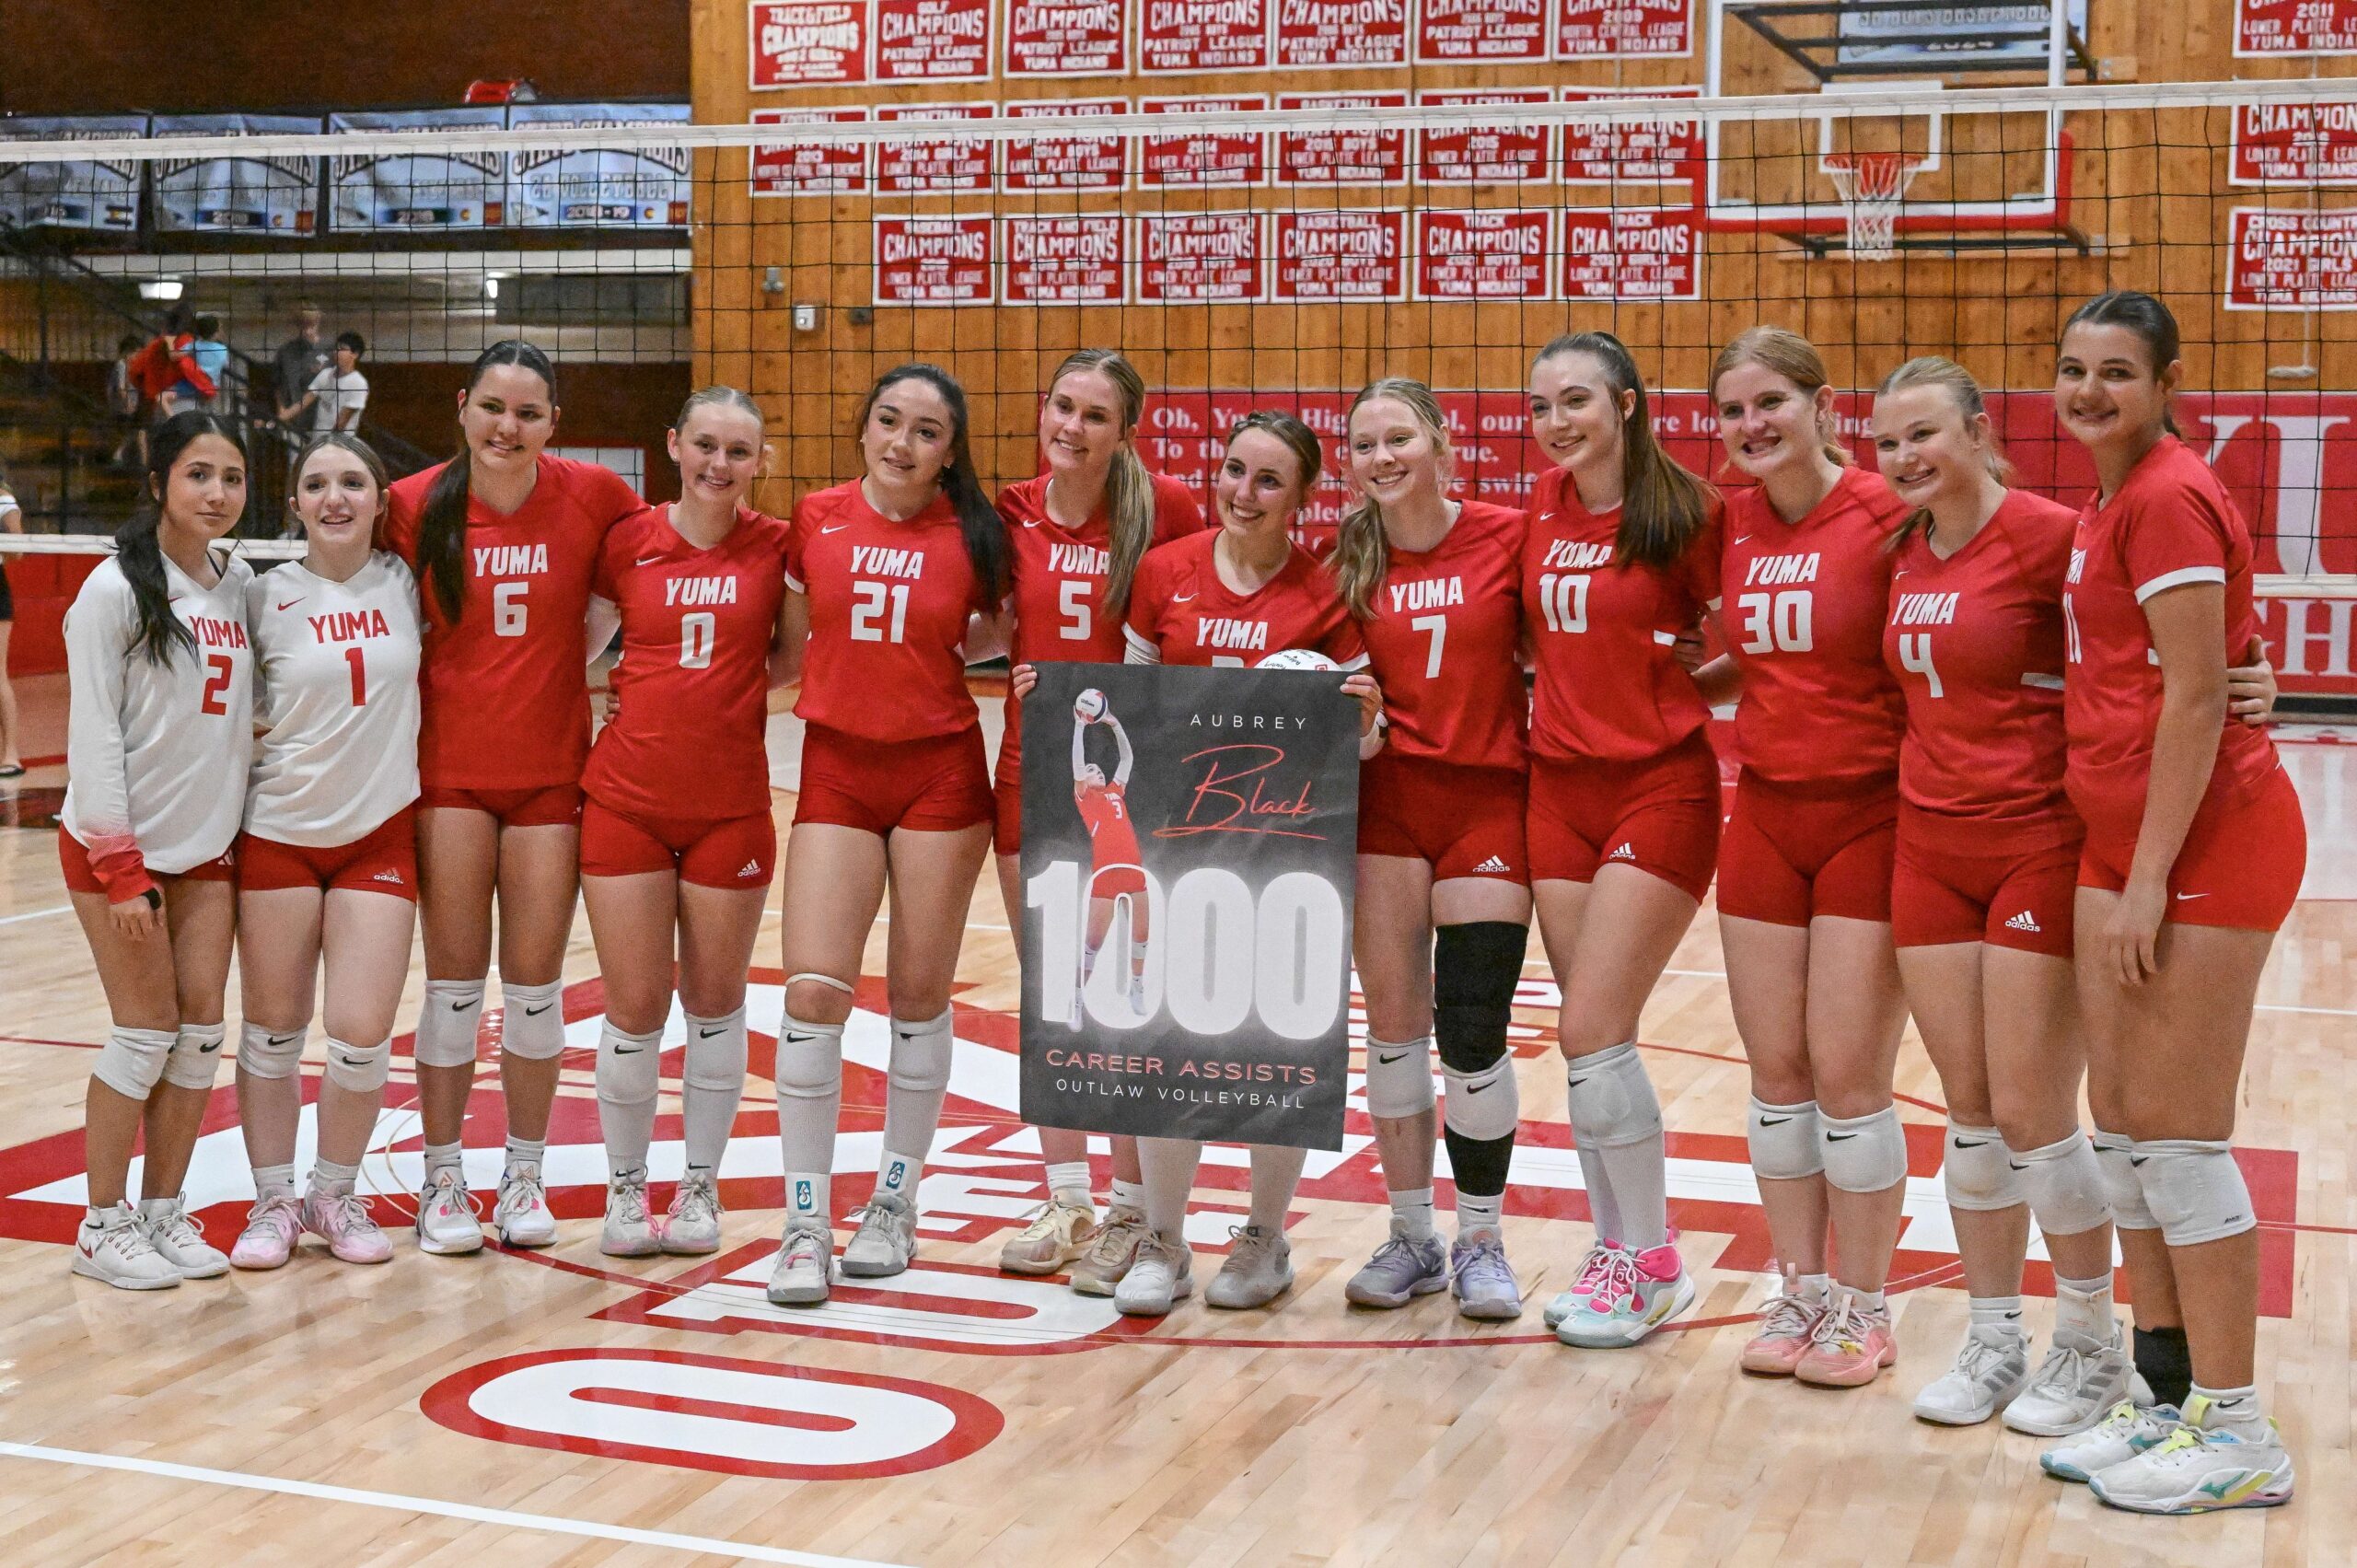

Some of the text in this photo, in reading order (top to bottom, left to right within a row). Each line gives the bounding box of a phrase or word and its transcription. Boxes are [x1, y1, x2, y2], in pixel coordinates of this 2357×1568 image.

[883, 8, 984, 42] CHAMPIONS
[1016, 2, 1120, 36] CHAMPIONS
[1151, 0, 1260, 30] CHAMPIONS
[1282, 0, 1402, 26] CHAMPIONS
[2296, 2, 2334, 18] 2011
[761, 21, 859, 56] CHAMPIONS
[1281, 34, 1402, 51] PATRIOT LEAGUE
[1426, 23, 1540, 39] PATRIOT LEAGUE
[2243, 19, 2282, 35] LOWER
[2250, 33, 2357, 49] YUMA INDIA
[1014, 40, 1119, 55] PATRIOT LEAGUE
[1144, 35, 1264, 52] PATRIOT LEAGUE
[1152, 52, 1190, 66] YUMA
[1289, 50, 1327, 64] YUMA
[1437, 40, 1472, 53] YUMA
[1566, 39, 1608, 52] YUMA
[2247, 104, 2357, 135] CHAMPION
[2246, 147, 2281, 162] LOWER
[2333, 146, 2357, 161] LEA
[2258, 163, 2299, 177] YUMA
[1296, 215, 1381, 230] BASKETBALL
[1461, 214, 1506, 228] TRACK
[2248, 215, 2299, 231] CROSS
[885, 232, 985, 262] CHAMPIONS
[1014, 231, 1119, 262] CHAMPIONS
[1148, 229, 1255, 261] CHAMPIONS
[1284, 227, 1395, 259] CHAMPIONS
[1429, 226, 1541, 256] CHAMPIONS
[1572, 225, 1689, 256] CHAMPIONS
[2243, 230, 2357, 261] CHAMPION
[1437, 281, 1472, 295] YUMA
[1152, 407, 1199, 431] Oh,
[1301, 408, 1348, 436] Hig
[1480, 415, 1530, 432] our
[1152, 437, 1184, 459] To
[1199, 437, 1228, 459] th
[1478, 471, 1538, 494] swif
[473, 543, 549, 578] YUMA
[850, 544, 924, 580] YUMA
[1047, 542, 1110, 583] YUMA
[1541, 539, 1612, 569] YUMA
[1744, 552, 1820, 587] YUMA
[666, 575, 737, 608] YUMA
[1390, 575, 1464, 613] YUMA
[1538, 573, 1591, 634] 10
[493, 581, 529, 637] 6
[851, 581, 911, 645] 21
[1058, 580, 1092, 648] 5
[1738, 589, 1813, 655] 30
[1890, 591, 1960, 626] YUMA
[188, 615, 249, 650] YUMA
[308, 609, 391, 645] YUMA
[679, 611, 715, 670] 0
[1196, 616, 1268, 652] YUMA
[1411, 614, 1446, 679] 7
[344, 646, 366, 707] 1
[1898, 633, 1945, 699] 4
[201, 653, 233, 716] 2
[1190, 714, 1307, 732] AUBREY
[1178, 743, 1318, 832] Black
[1111, 801, 1123, 819] 3
[1608, 852, 1637, 861] adidas
[2004, 920, 2041, 933] adidas
[1026, 860, 1345, 1041] 1000
[1045, 1049, 1318, 1086] CAREER ASSISTS
[1055, 1079, 1307, 1110] OUTLAW VOLLEYBALL
